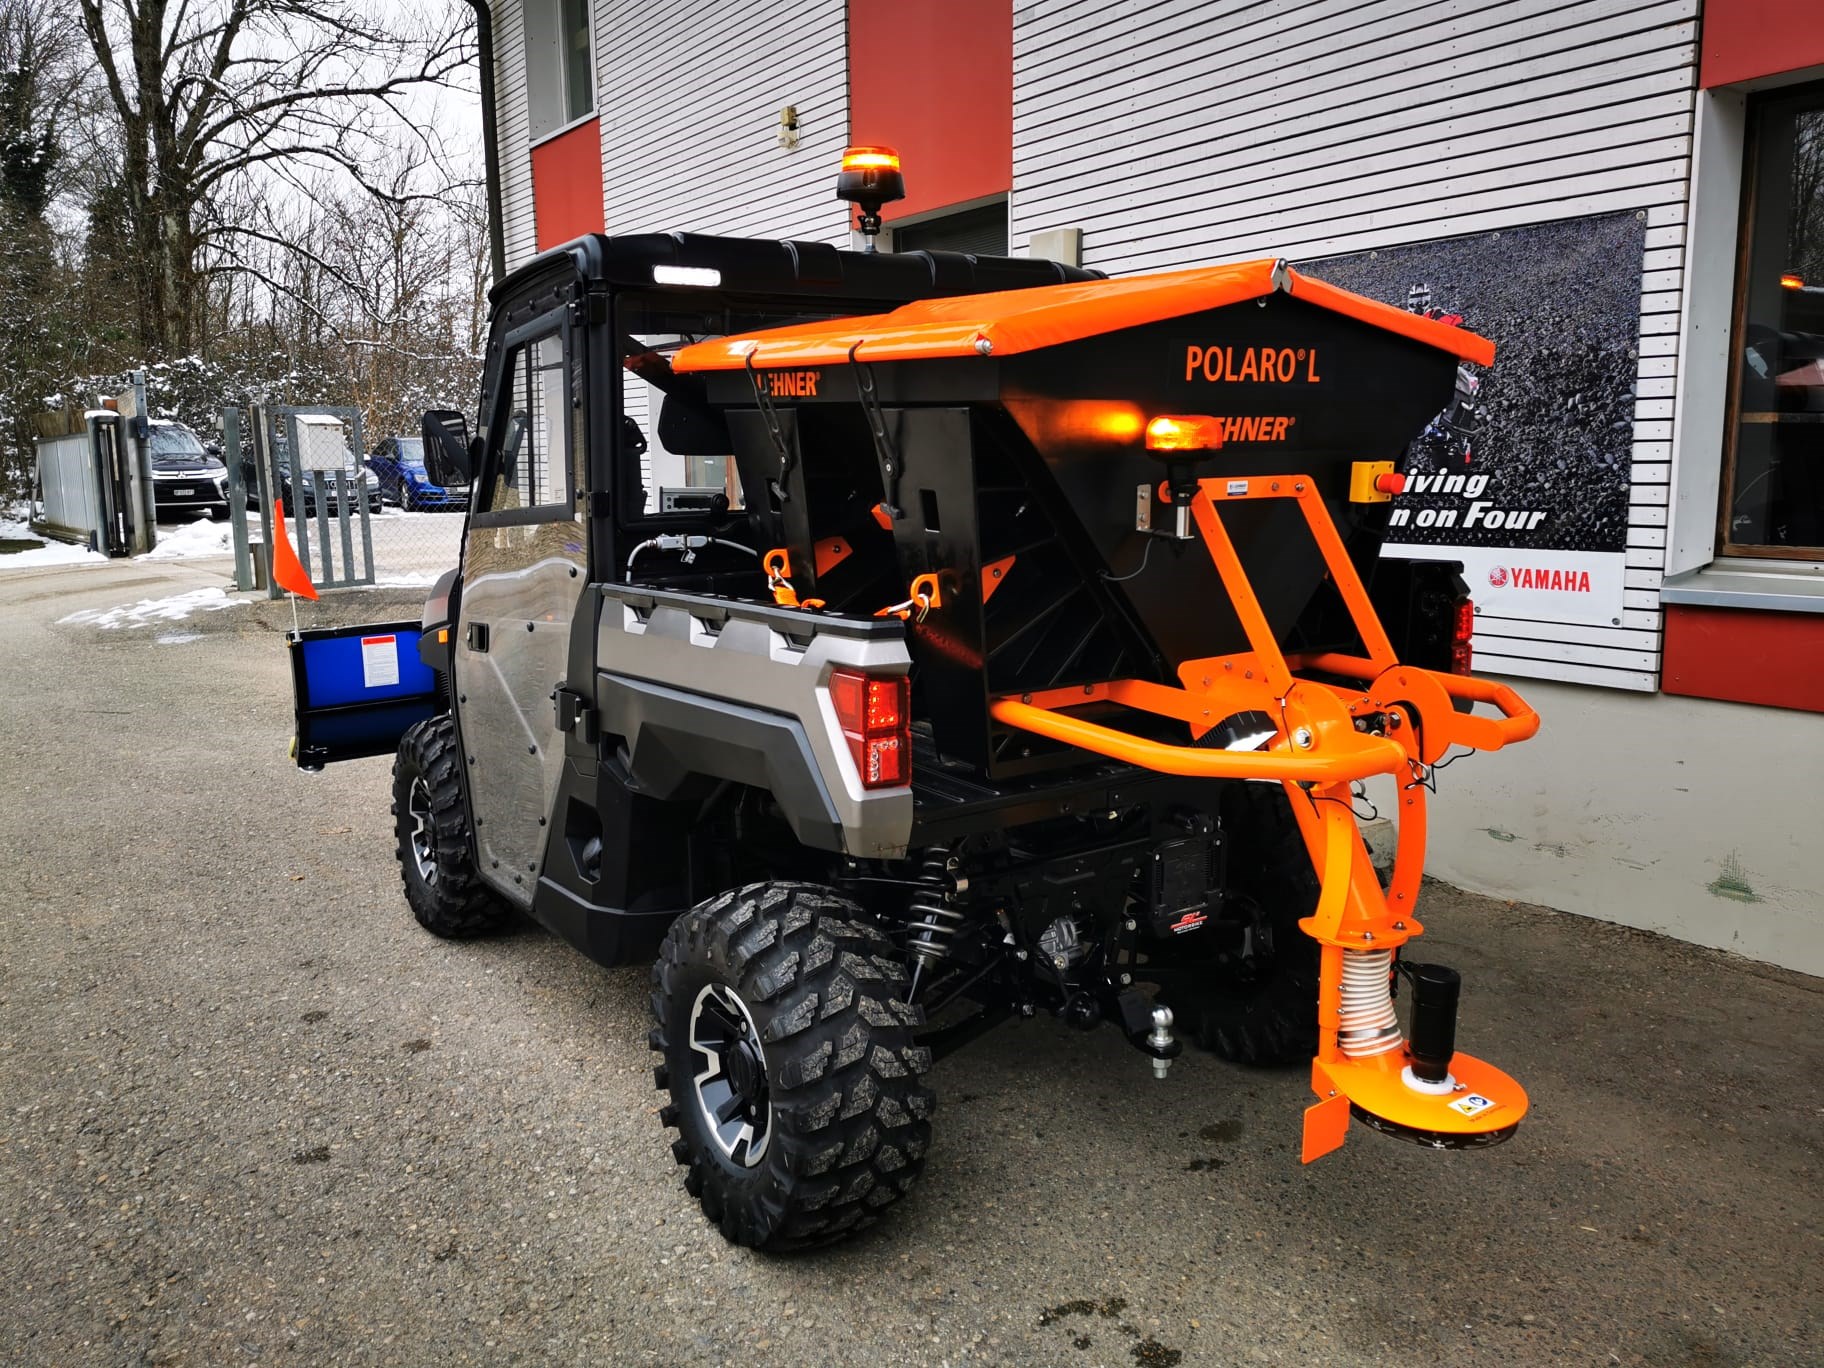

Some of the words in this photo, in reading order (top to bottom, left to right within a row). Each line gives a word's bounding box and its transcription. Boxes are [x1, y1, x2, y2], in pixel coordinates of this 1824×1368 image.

[1307, 349, 1320, 382] L
[1402, 468, 1489, 498] iving
[1415, 509, 1458, 528] on
[1463, 501, 1546, 530] Four
[1511, 568, 1591, 592] YAMAHA
